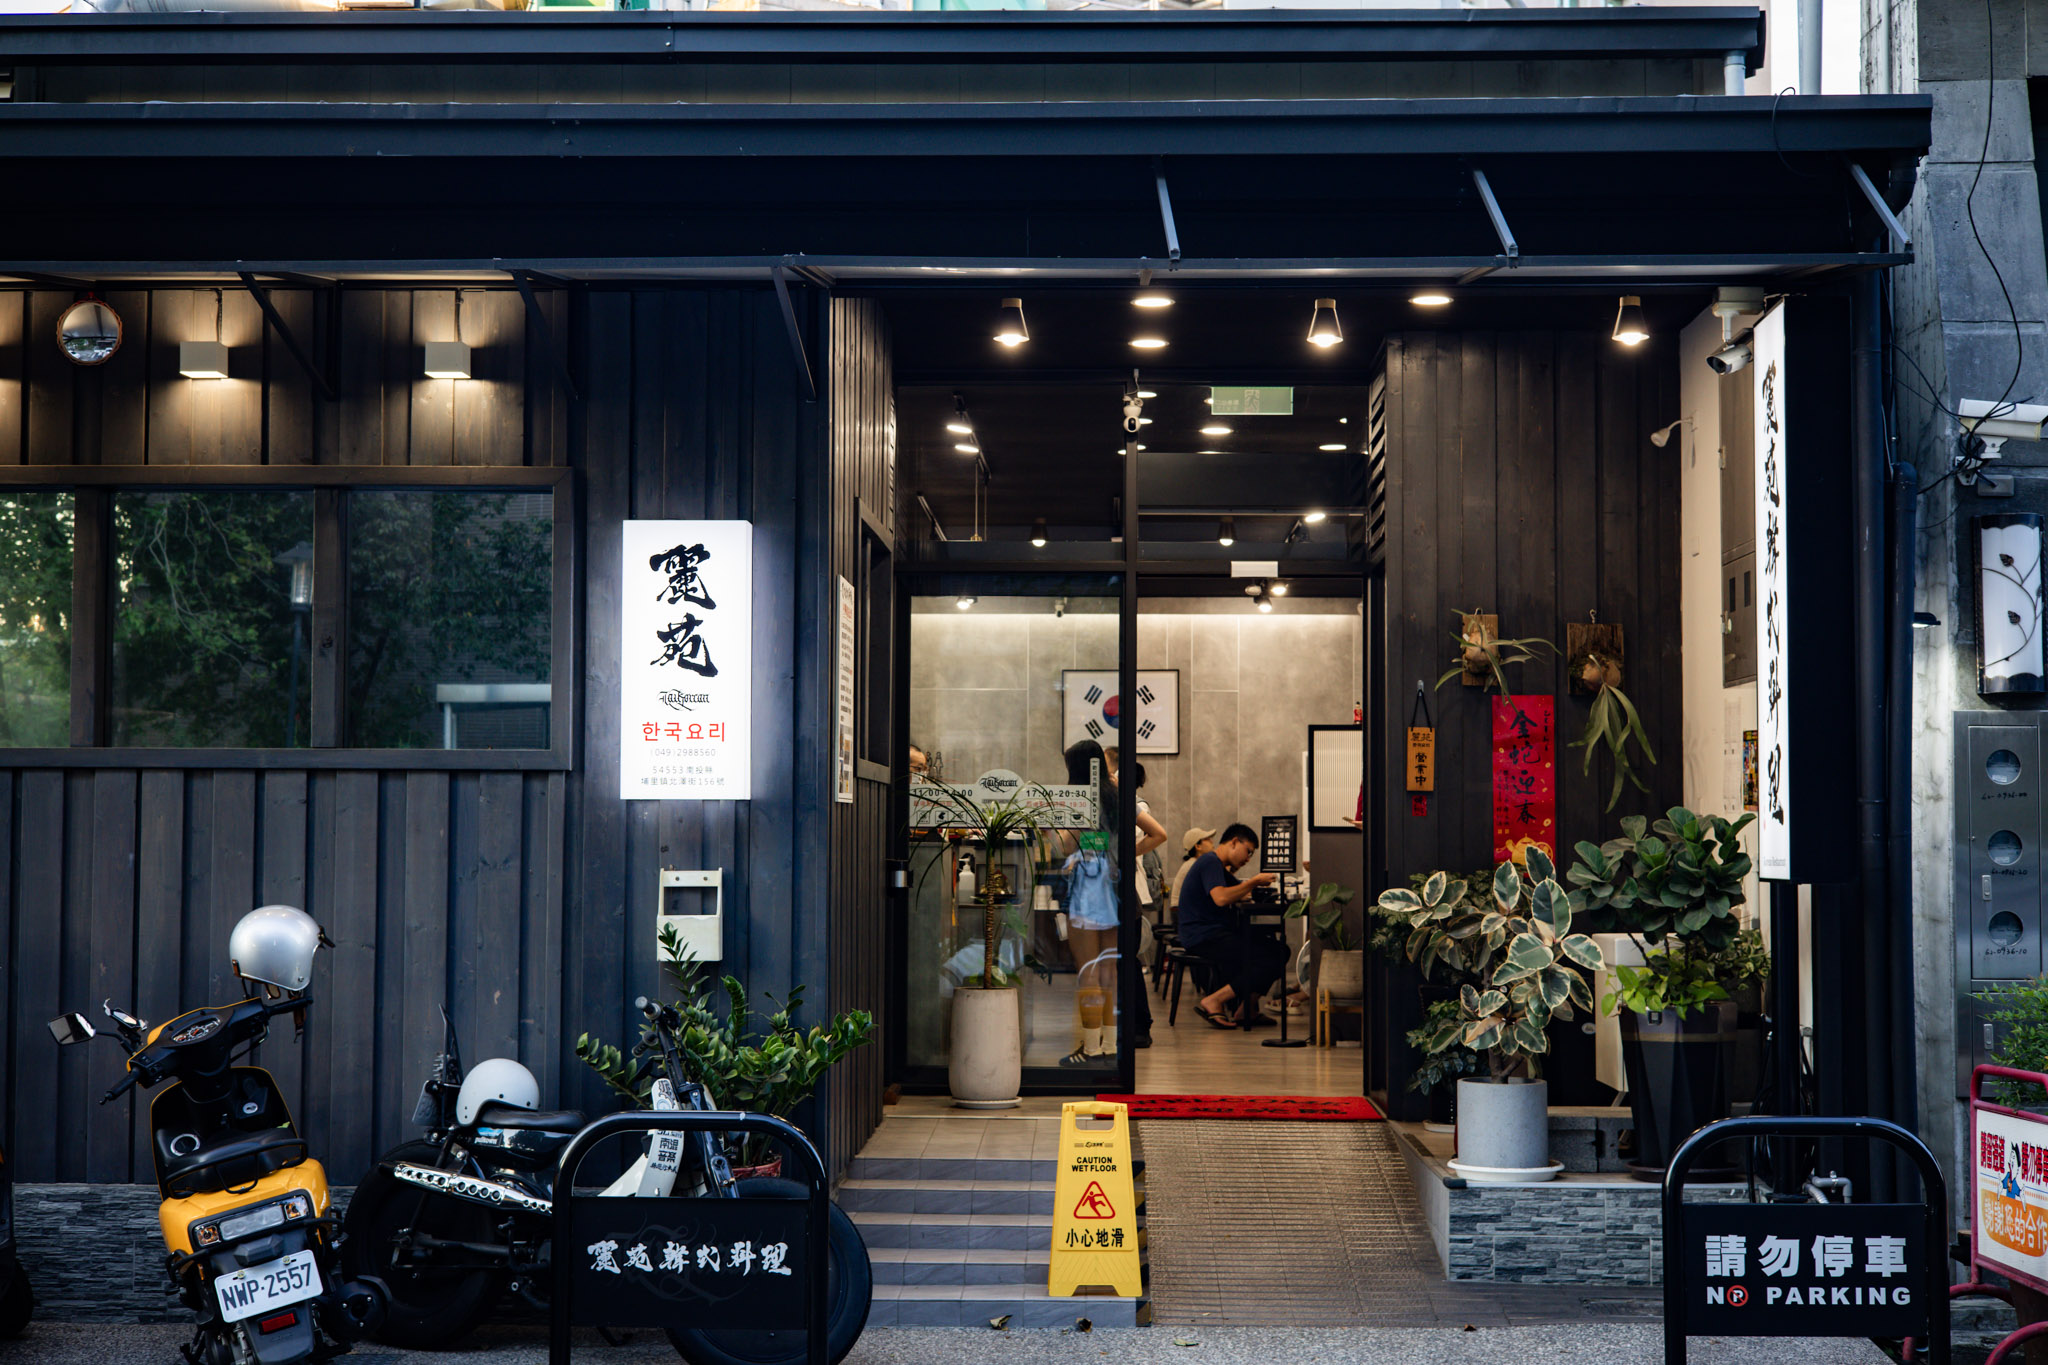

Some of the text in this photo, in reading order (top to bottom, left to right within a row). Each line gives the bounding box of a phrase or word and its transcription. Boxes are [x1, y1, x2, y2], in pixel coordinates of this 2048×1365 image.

[649, 543, 719, 678] 麗苑
[1761, 359, 1785, 826] 麗苑韓式料理
[641, 721, 726, 742] 한국요리
[1414, 752, 1428, 786] 營業中
[1508, 709, 1541, 825] 金蛇迎春
[1071, 1164, 1118, 1173] WET FLOOR
[1076, 1156, 1113, 1164] CAUTION
[1065, 1228, 1125, 1248] 小心地滑
[1984, 1197, 2048, 1251] 謝謝您的合作
[586, 1239, 793, 1277] 麗苑韓式料理
[1705, 1234, 1908, 1278] 請勿停車
[1766, 1286, 1912, 1306] PARKING
